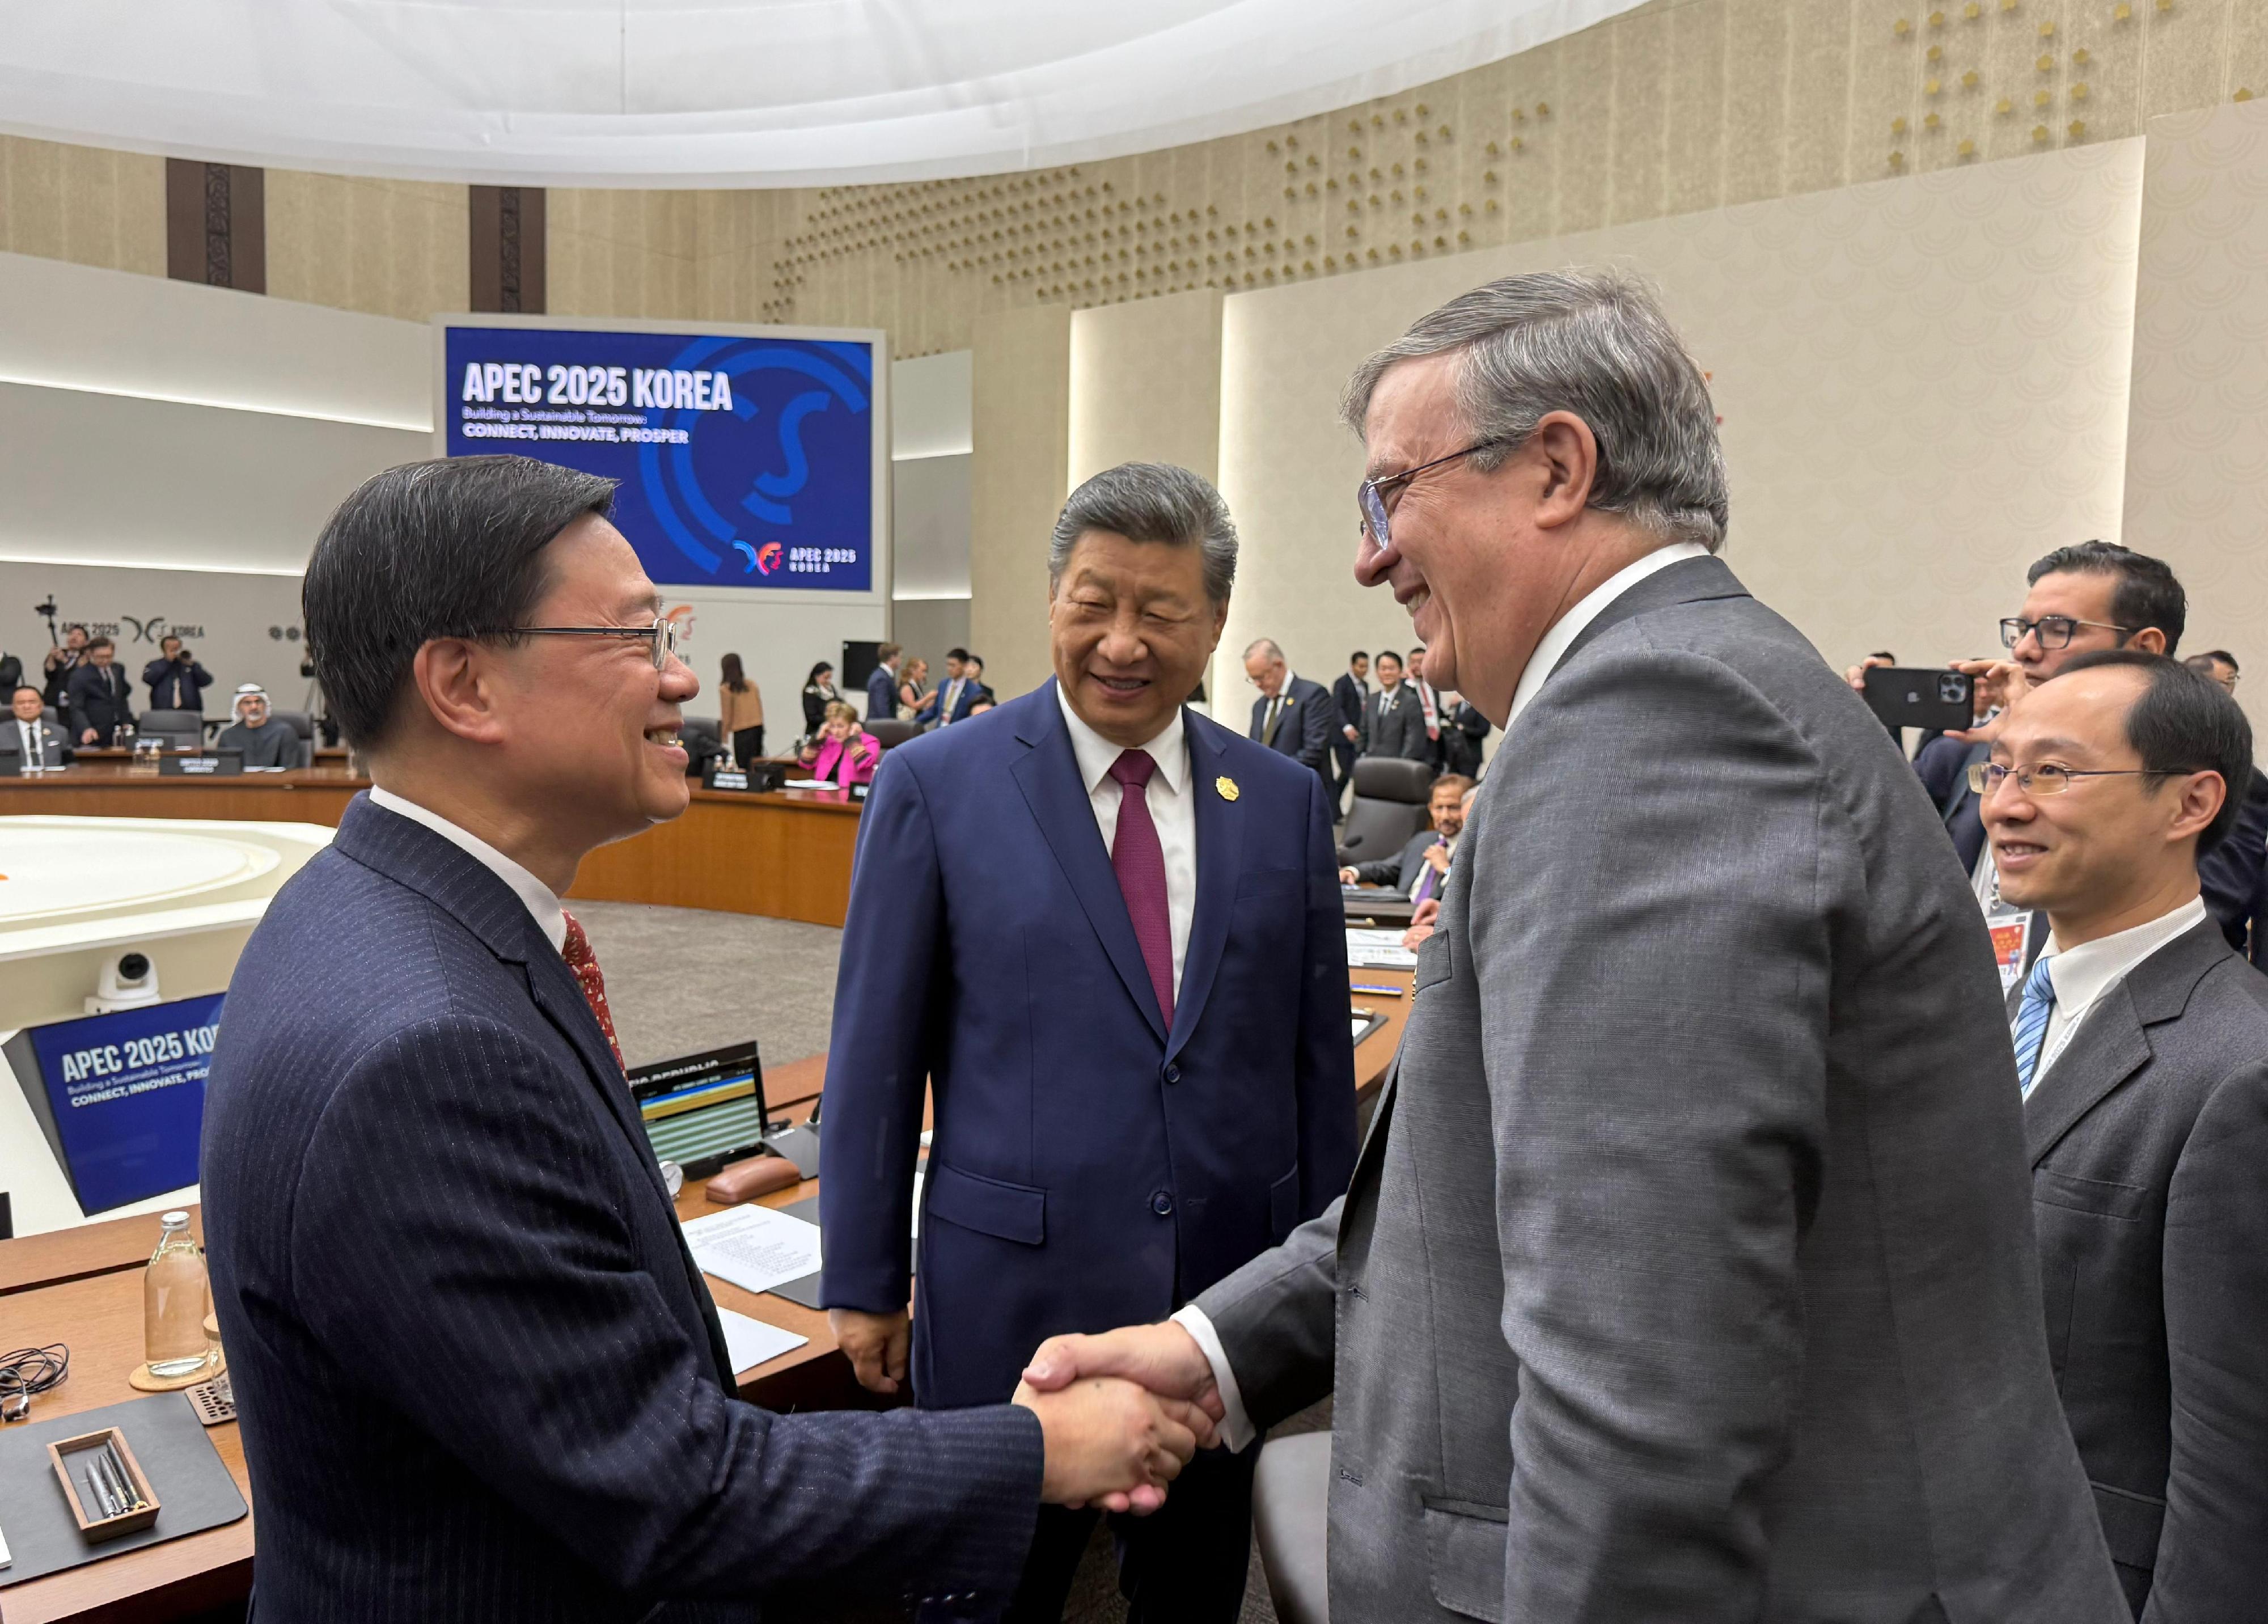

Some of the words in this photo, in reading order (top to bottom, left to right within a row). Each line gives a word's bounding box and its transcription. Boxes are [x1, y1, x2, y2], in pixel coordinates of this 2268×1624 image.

[463, 362, 542, 403] APEC
[547, 365, 627, 406] 2025
[632, 368, 733, 411] KOREA
[462, 406, 510, 422] Building
[511, 410, 519, 420] a
[519, 408, 586, 422] Sustainable
[463, 422, 538, 441] CONNECT,
[539, 425, 620, 443] INNOVATE,
[620, 428, 689, 444] PROSPER
[789, 547, 822, 562] APEC
[824, 548, 856, 563] 2025
[789, 561, 830, 573] KOREA
[62, 1045, 123, 1083] APEC
[124, 1031, 184, 1069] 2025
[71, 1086, 129, 1107] CONNECT,
[128, 1073, 187, 1095] INNOVATE,
[185, 1066, 210, 1081] PRO
